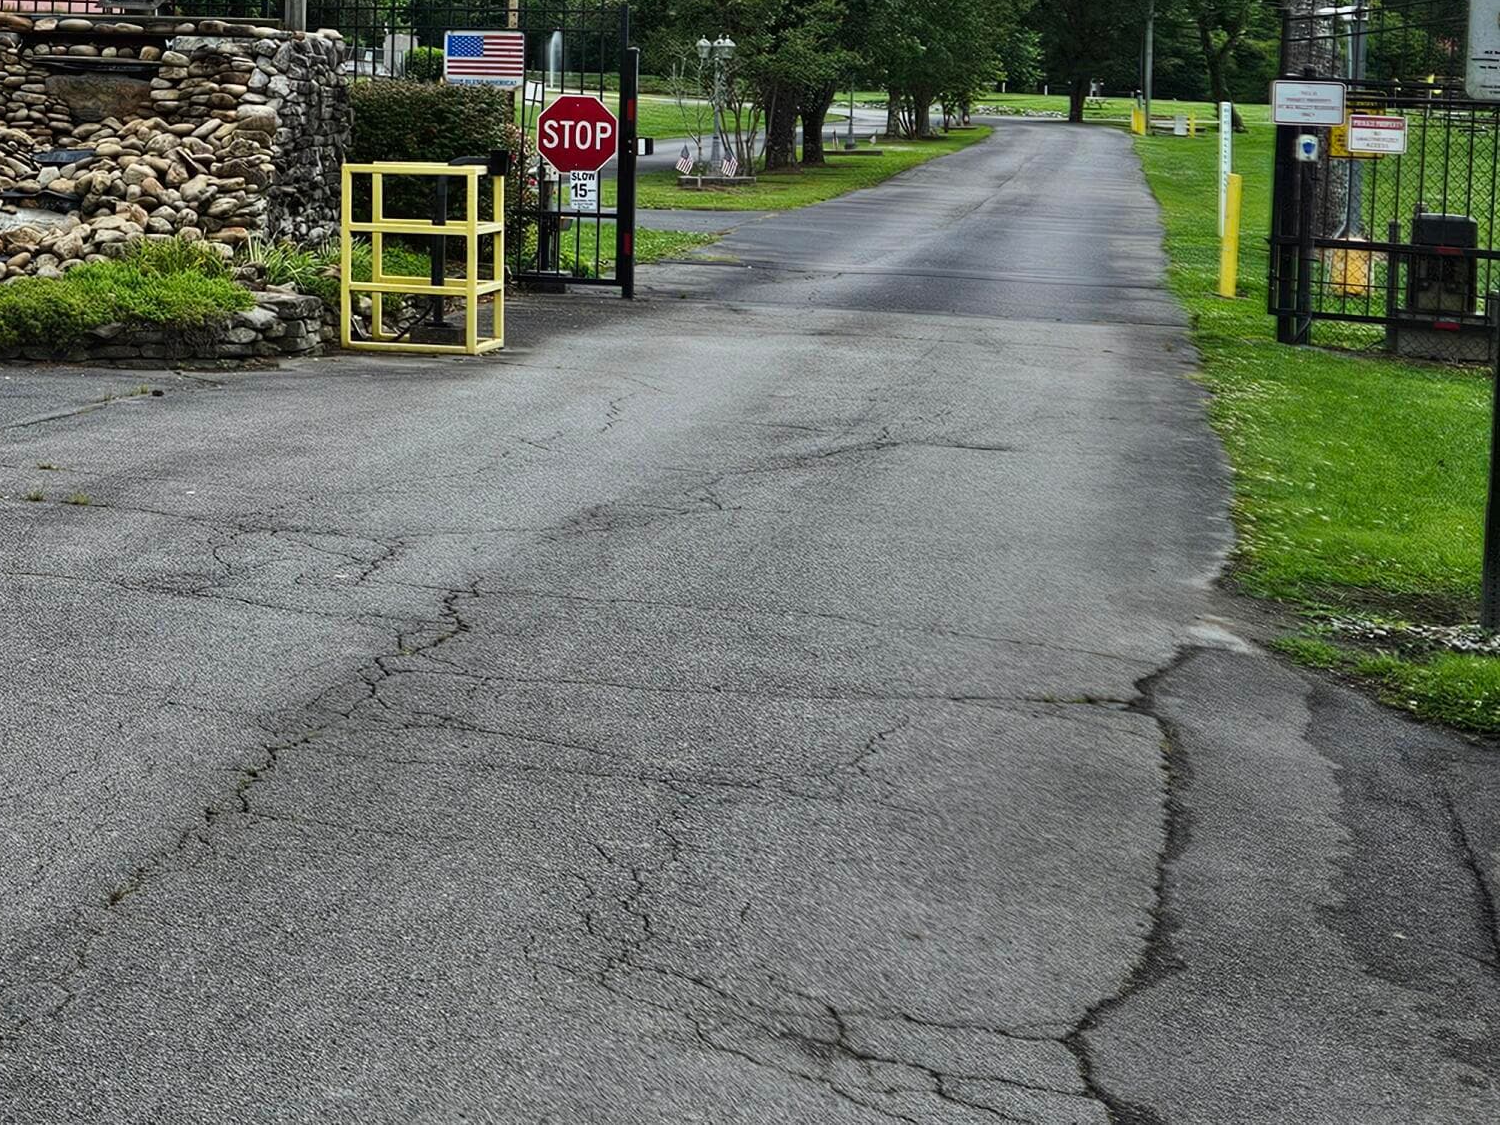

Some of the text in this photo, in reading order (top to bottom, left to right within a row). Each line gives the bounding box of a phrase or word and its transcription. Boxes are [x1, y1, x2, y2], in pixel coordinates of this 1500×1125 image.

[542, 119, 612, 151] STOP
[571, 172, 596, 181] SLOW
[571, 183, 588, 198] 15
